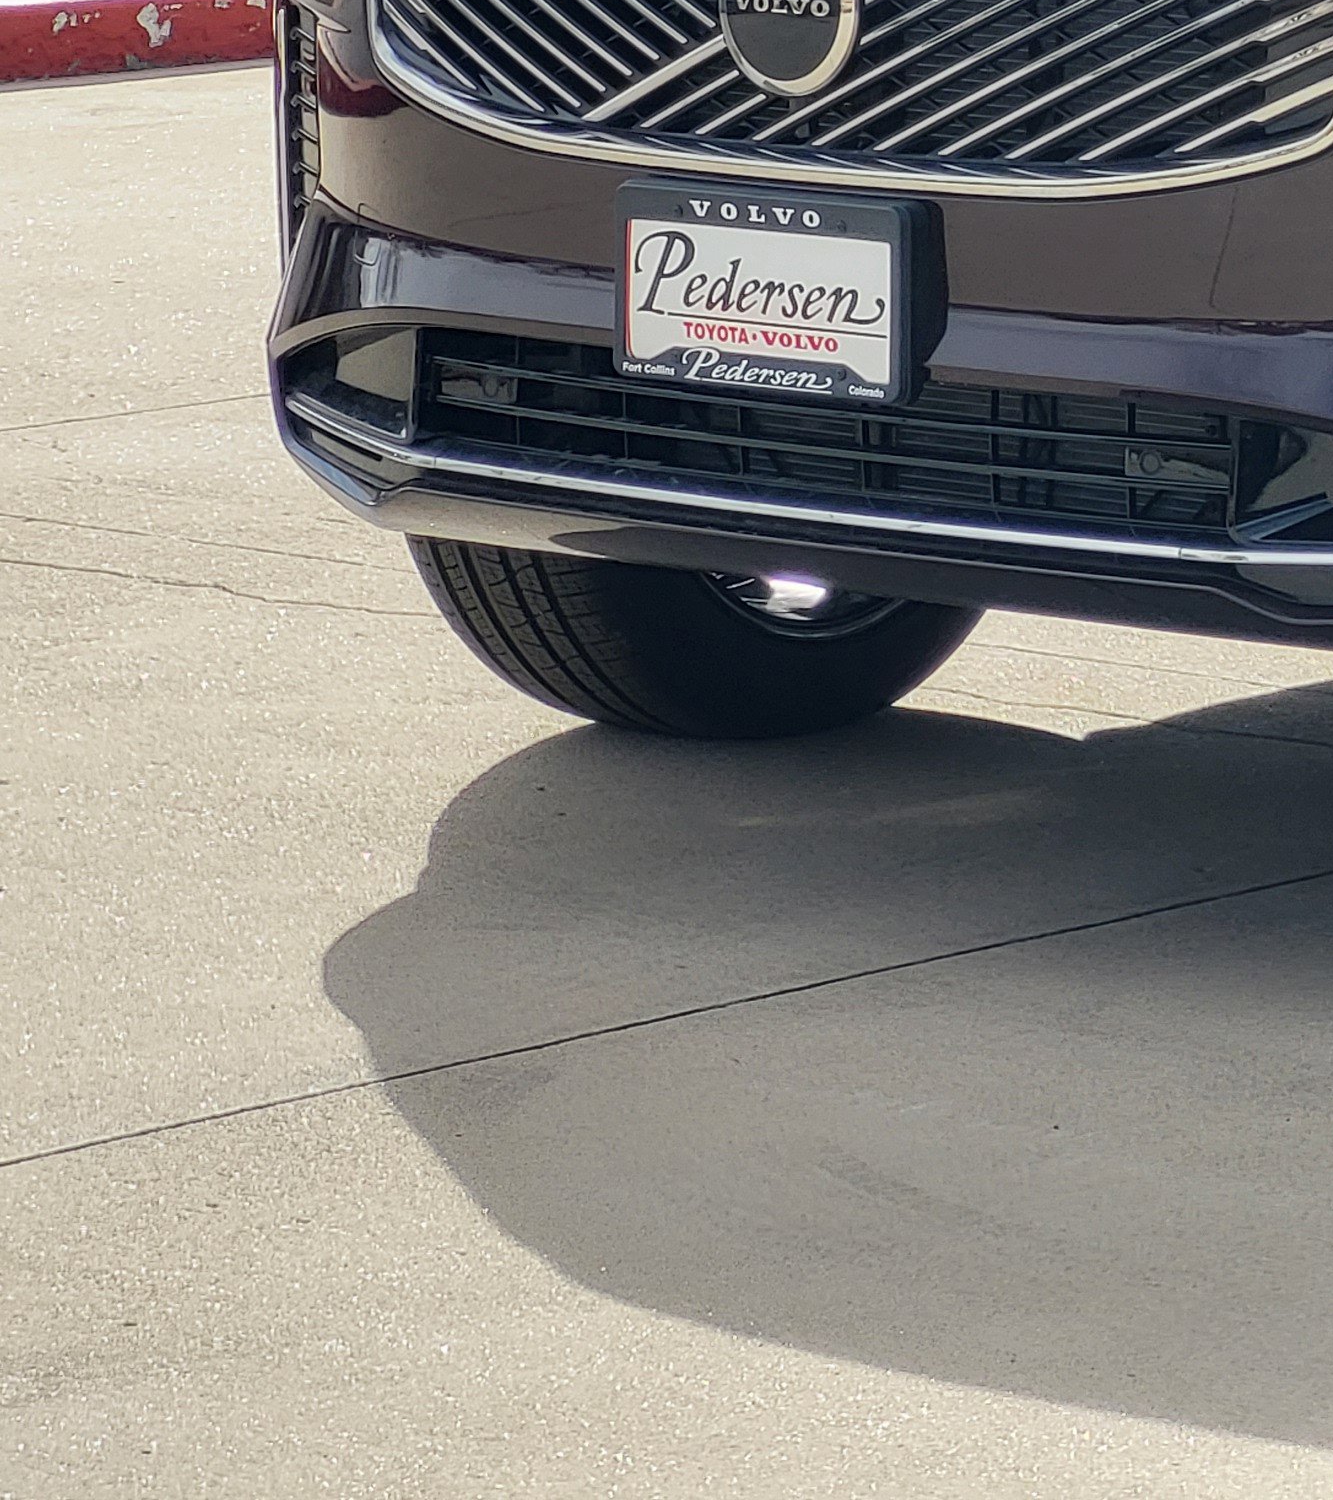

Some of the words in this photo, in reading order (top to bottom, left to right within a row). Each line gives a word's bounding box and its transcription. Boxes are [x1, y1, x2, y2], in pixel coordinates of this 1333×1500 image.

[689, 199, 822, 228] VOLVO
[635, 231, 886, 325] Pedersen
[622, 361, 643, 374] Fort
[643, 363, 675, 376] Collins
[681, 347, 833, 389] Pedersen
[848, 384, 885, 399] Colorado
